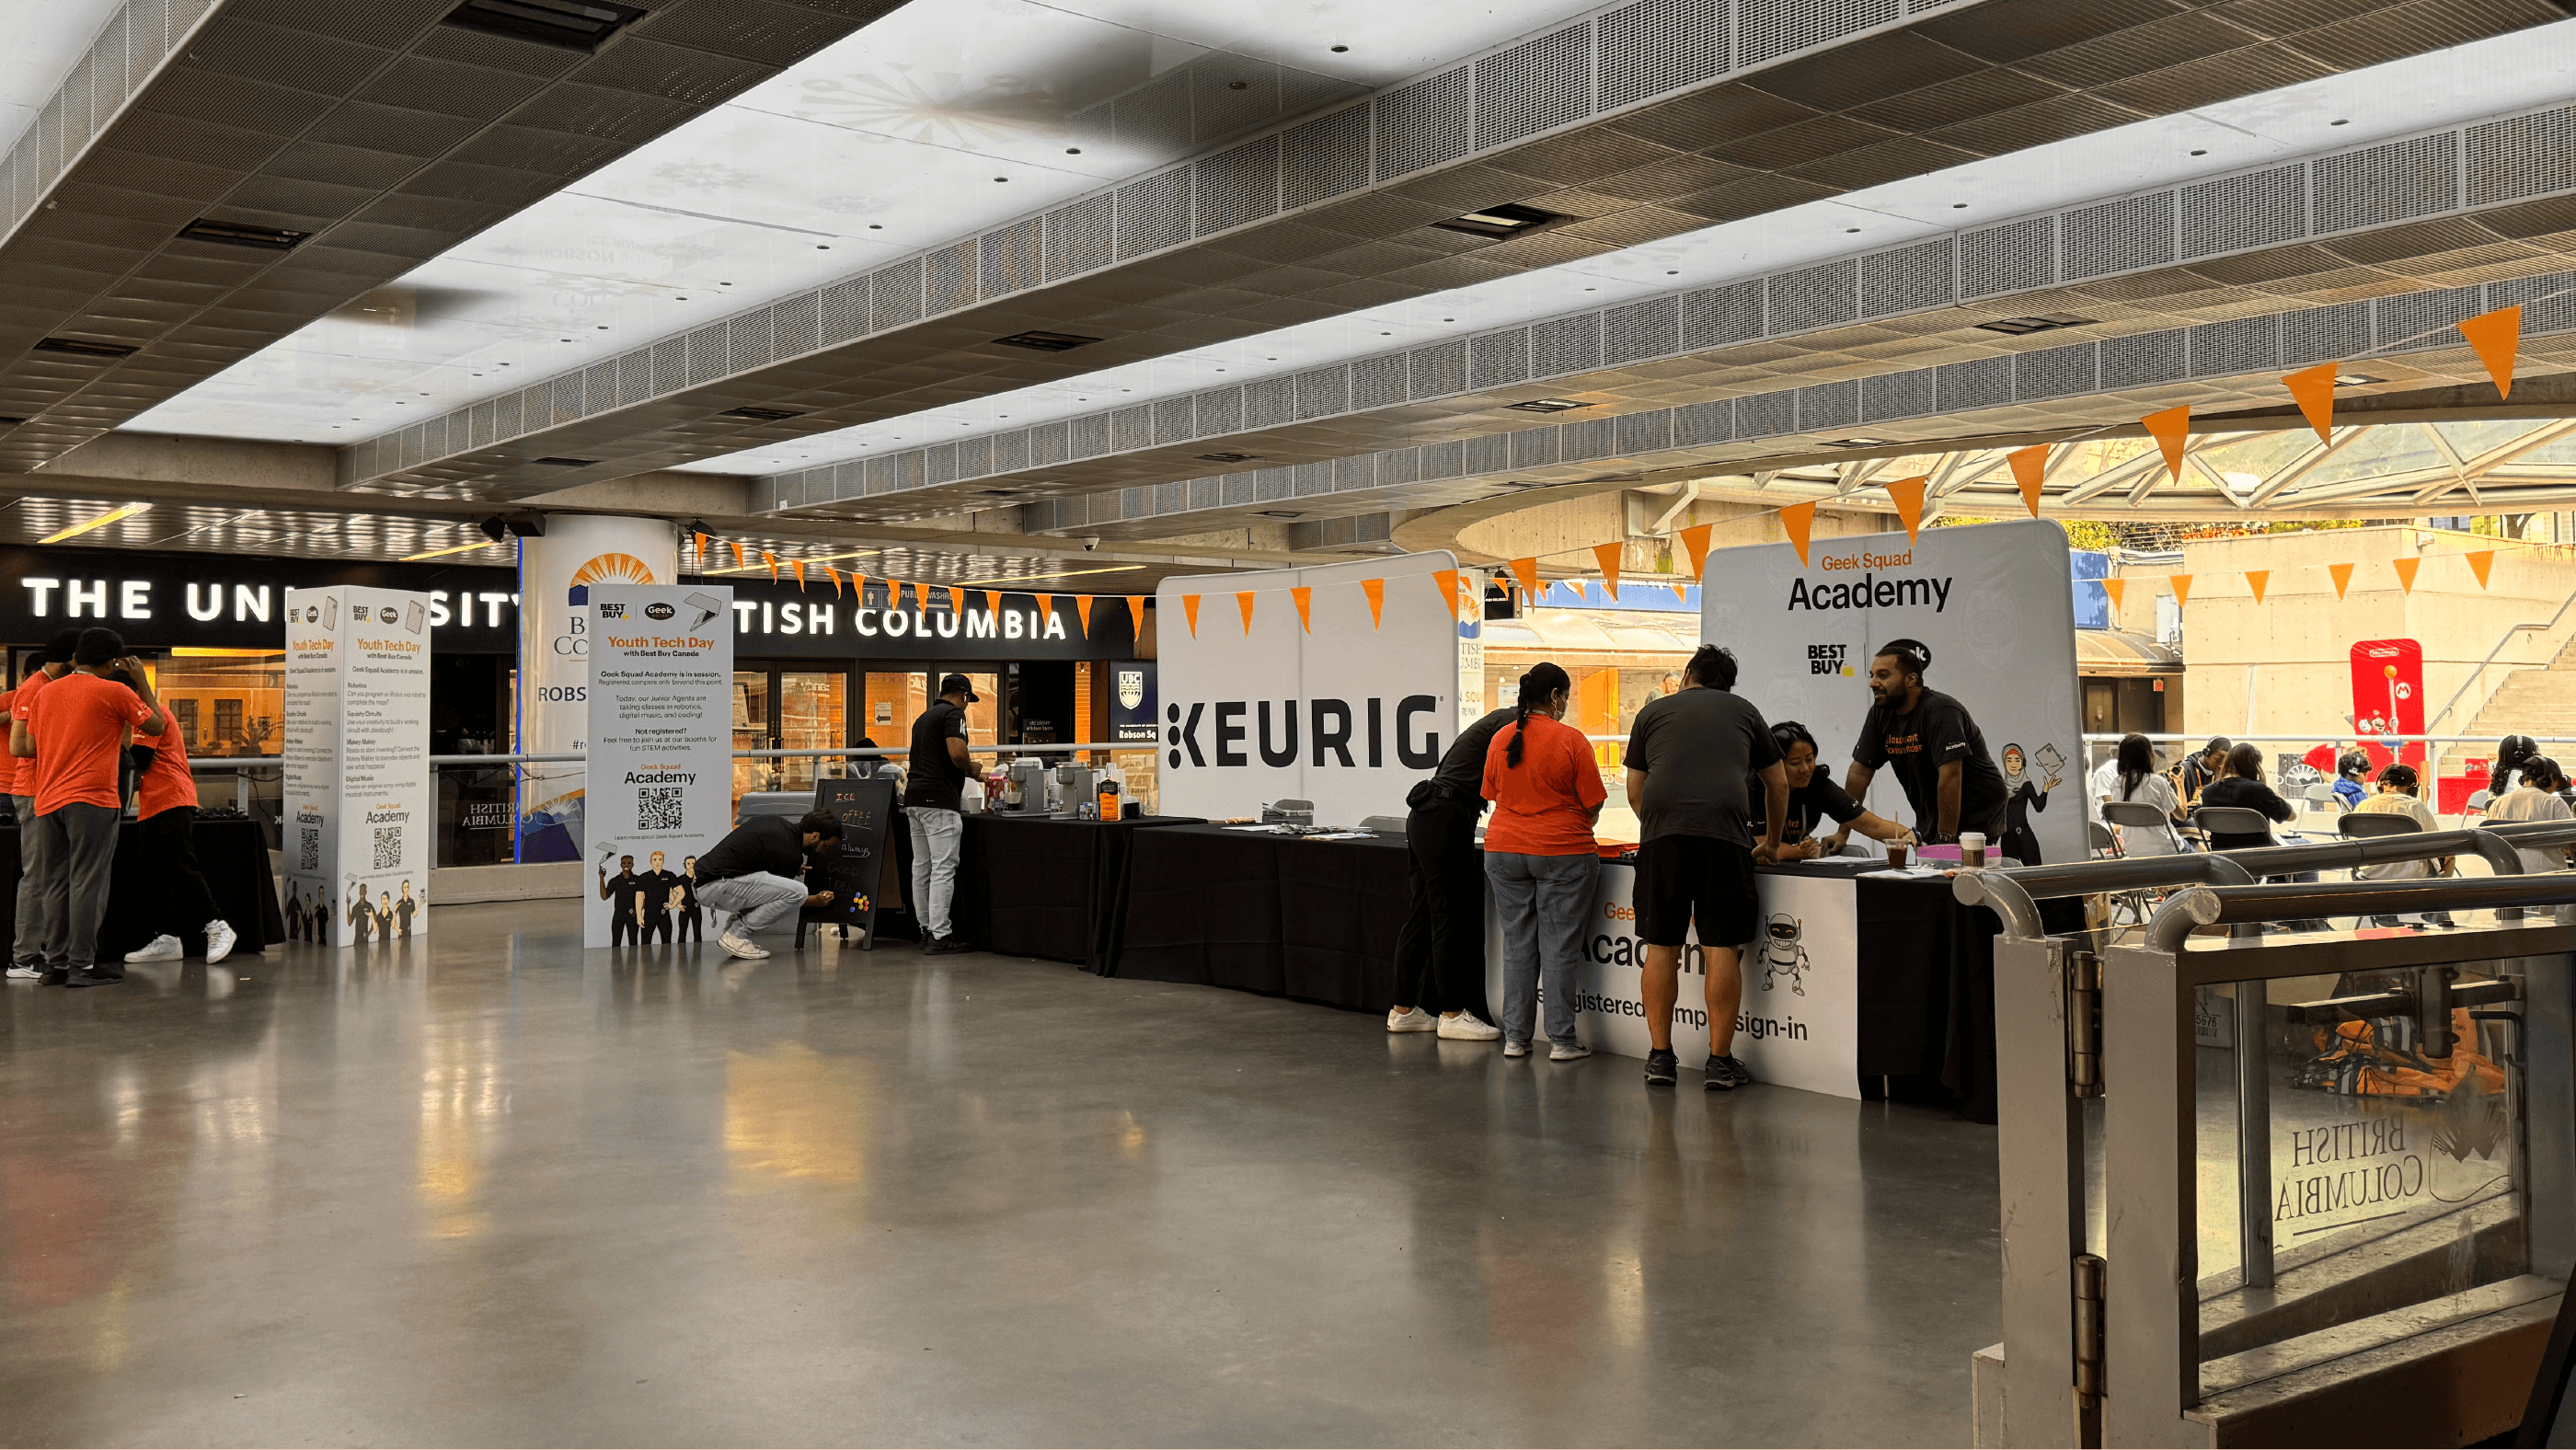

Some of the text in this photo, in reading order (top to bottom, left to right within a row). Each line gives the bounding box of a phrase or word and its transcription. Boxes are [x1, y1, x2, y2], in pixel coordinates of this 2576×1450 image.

[1822, 548, 1913, 571] Geek Squad
[902, 590, 917, 599] PUBL
[1788, 572, 1953, 614] Academy
[22, 579, 518, 627] THE UNSIT
[353, 605, 369, 614] BEST
[648, 605, 673, 615] Geek
[732, 602, 1067, 640] TISH COLUMBIA
[357, 639, 420, 654] Youth Tech Day
[608, 637, 715, 650] Youth Tech Day
[1808, 644, 1847, 660] BEST
[1811, 660, 1845, 675] BUY
[1121, 673, 1141, 684] UBC
[538, 686, 587, 701] ROBS
[1119, 731, 1145, 740] Robson
[1167, 695, 1439, 770] KEURIG
[624, 771, 696, 786] Academy
[835, 793, 855, 801] ICE
[296, 811, 325, 827] Academy
[366, 811, 409, 824] Academy
[842, 810, 871, 825] OFFEE
[1604, 902, 1636, 922] Gee
[1735, 1011, 1809, 1041] sign-in
